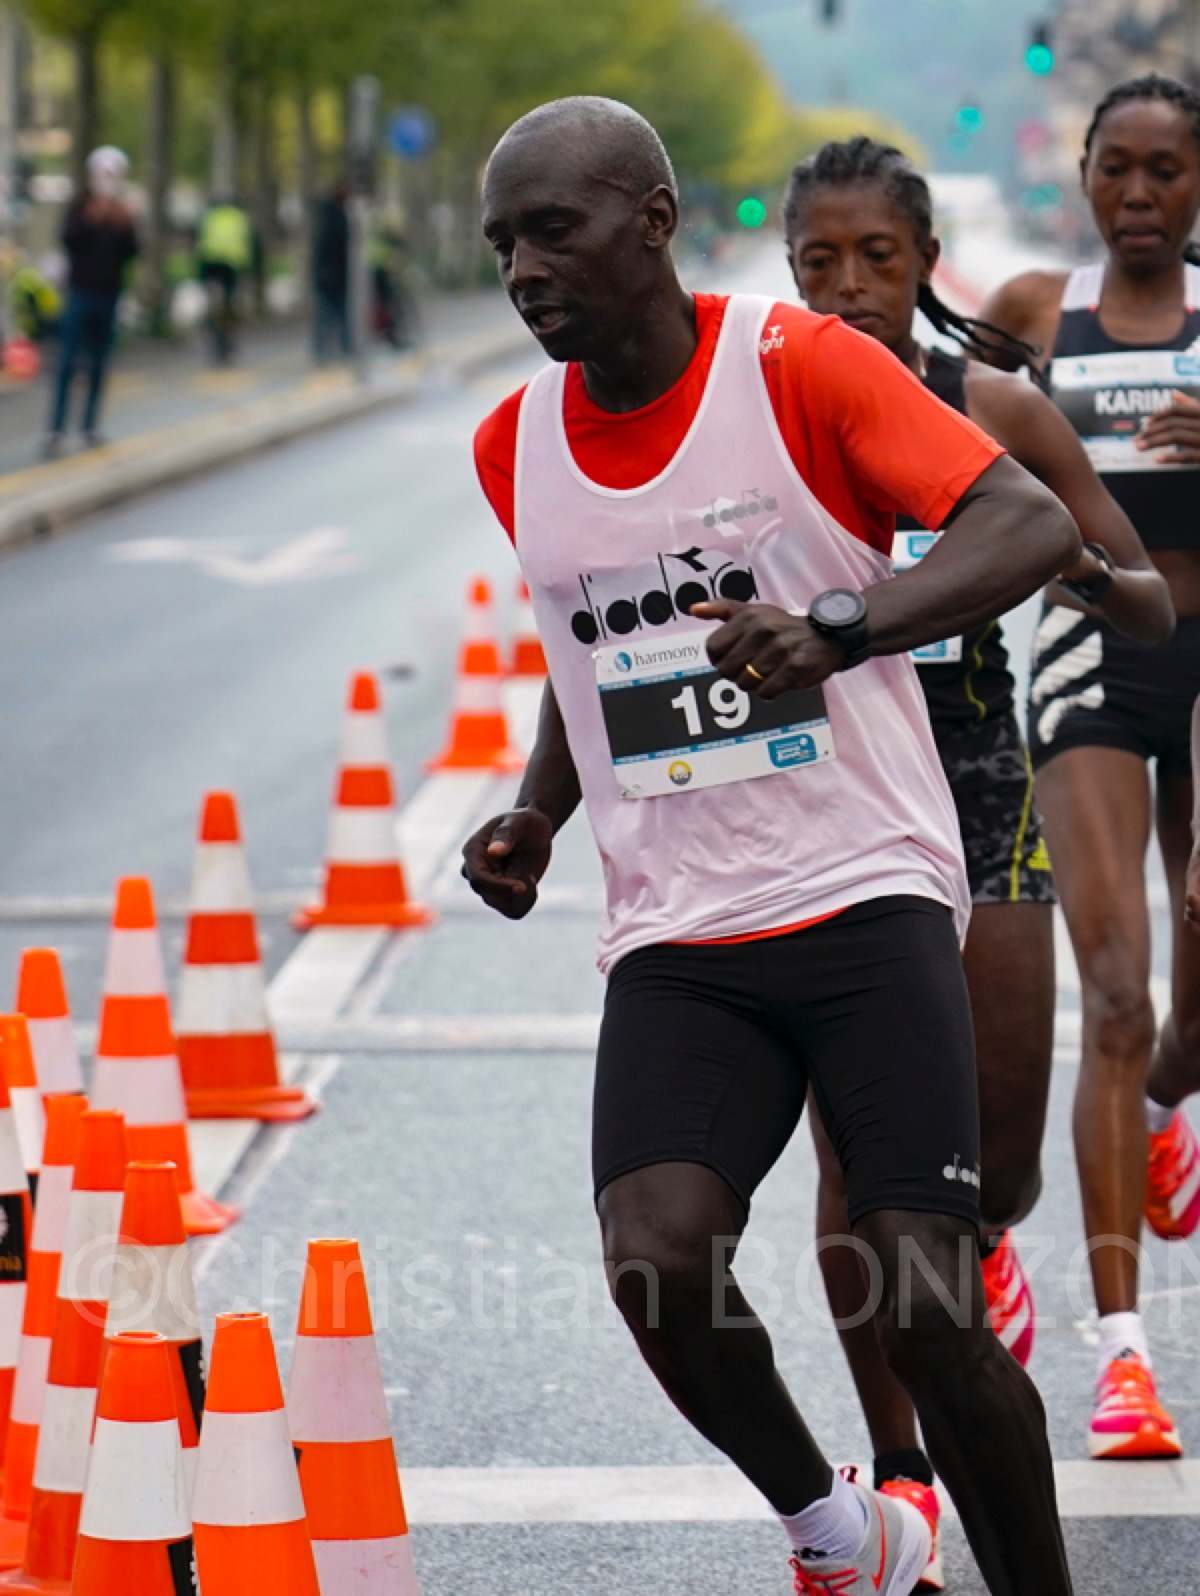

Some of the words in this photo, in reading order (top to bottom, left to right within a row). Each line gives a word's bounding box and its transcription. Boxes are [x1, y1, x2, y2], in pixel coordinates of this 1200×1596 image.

[1094, 387, 1178, 416] KARIM
[702, 490, 779, 529] diadora
[570, 551, 760, 645] diadora
[633, 644, 701, 668] harmony
[670, 677, 751, 737] 19
